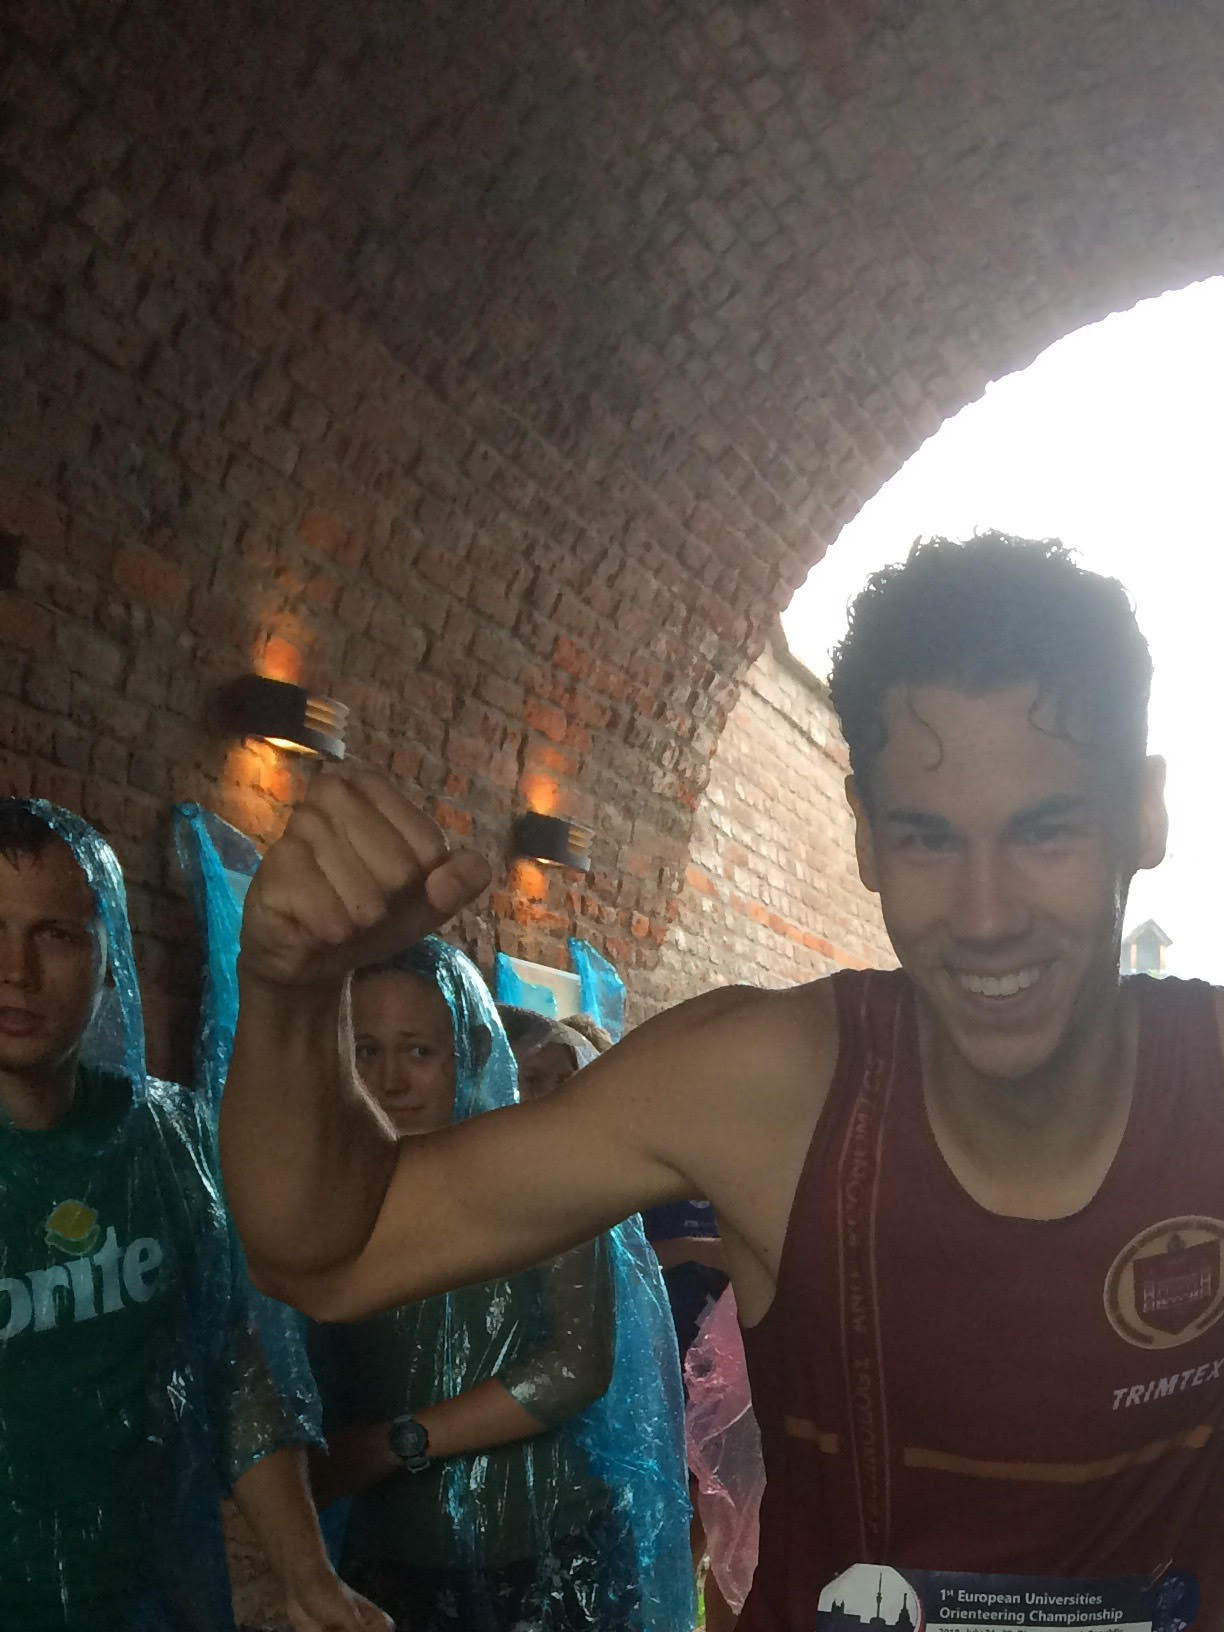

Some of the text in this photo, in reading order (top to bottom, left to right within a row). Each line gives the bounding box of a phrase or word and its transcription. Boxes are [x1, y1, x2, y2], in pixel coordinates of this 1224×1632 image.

[957, 1590, 1022, 1606] European
[1025, 1593, 1103, 1606] Universities
[939, 1606, 1125, 1624] Orienteering Championship
